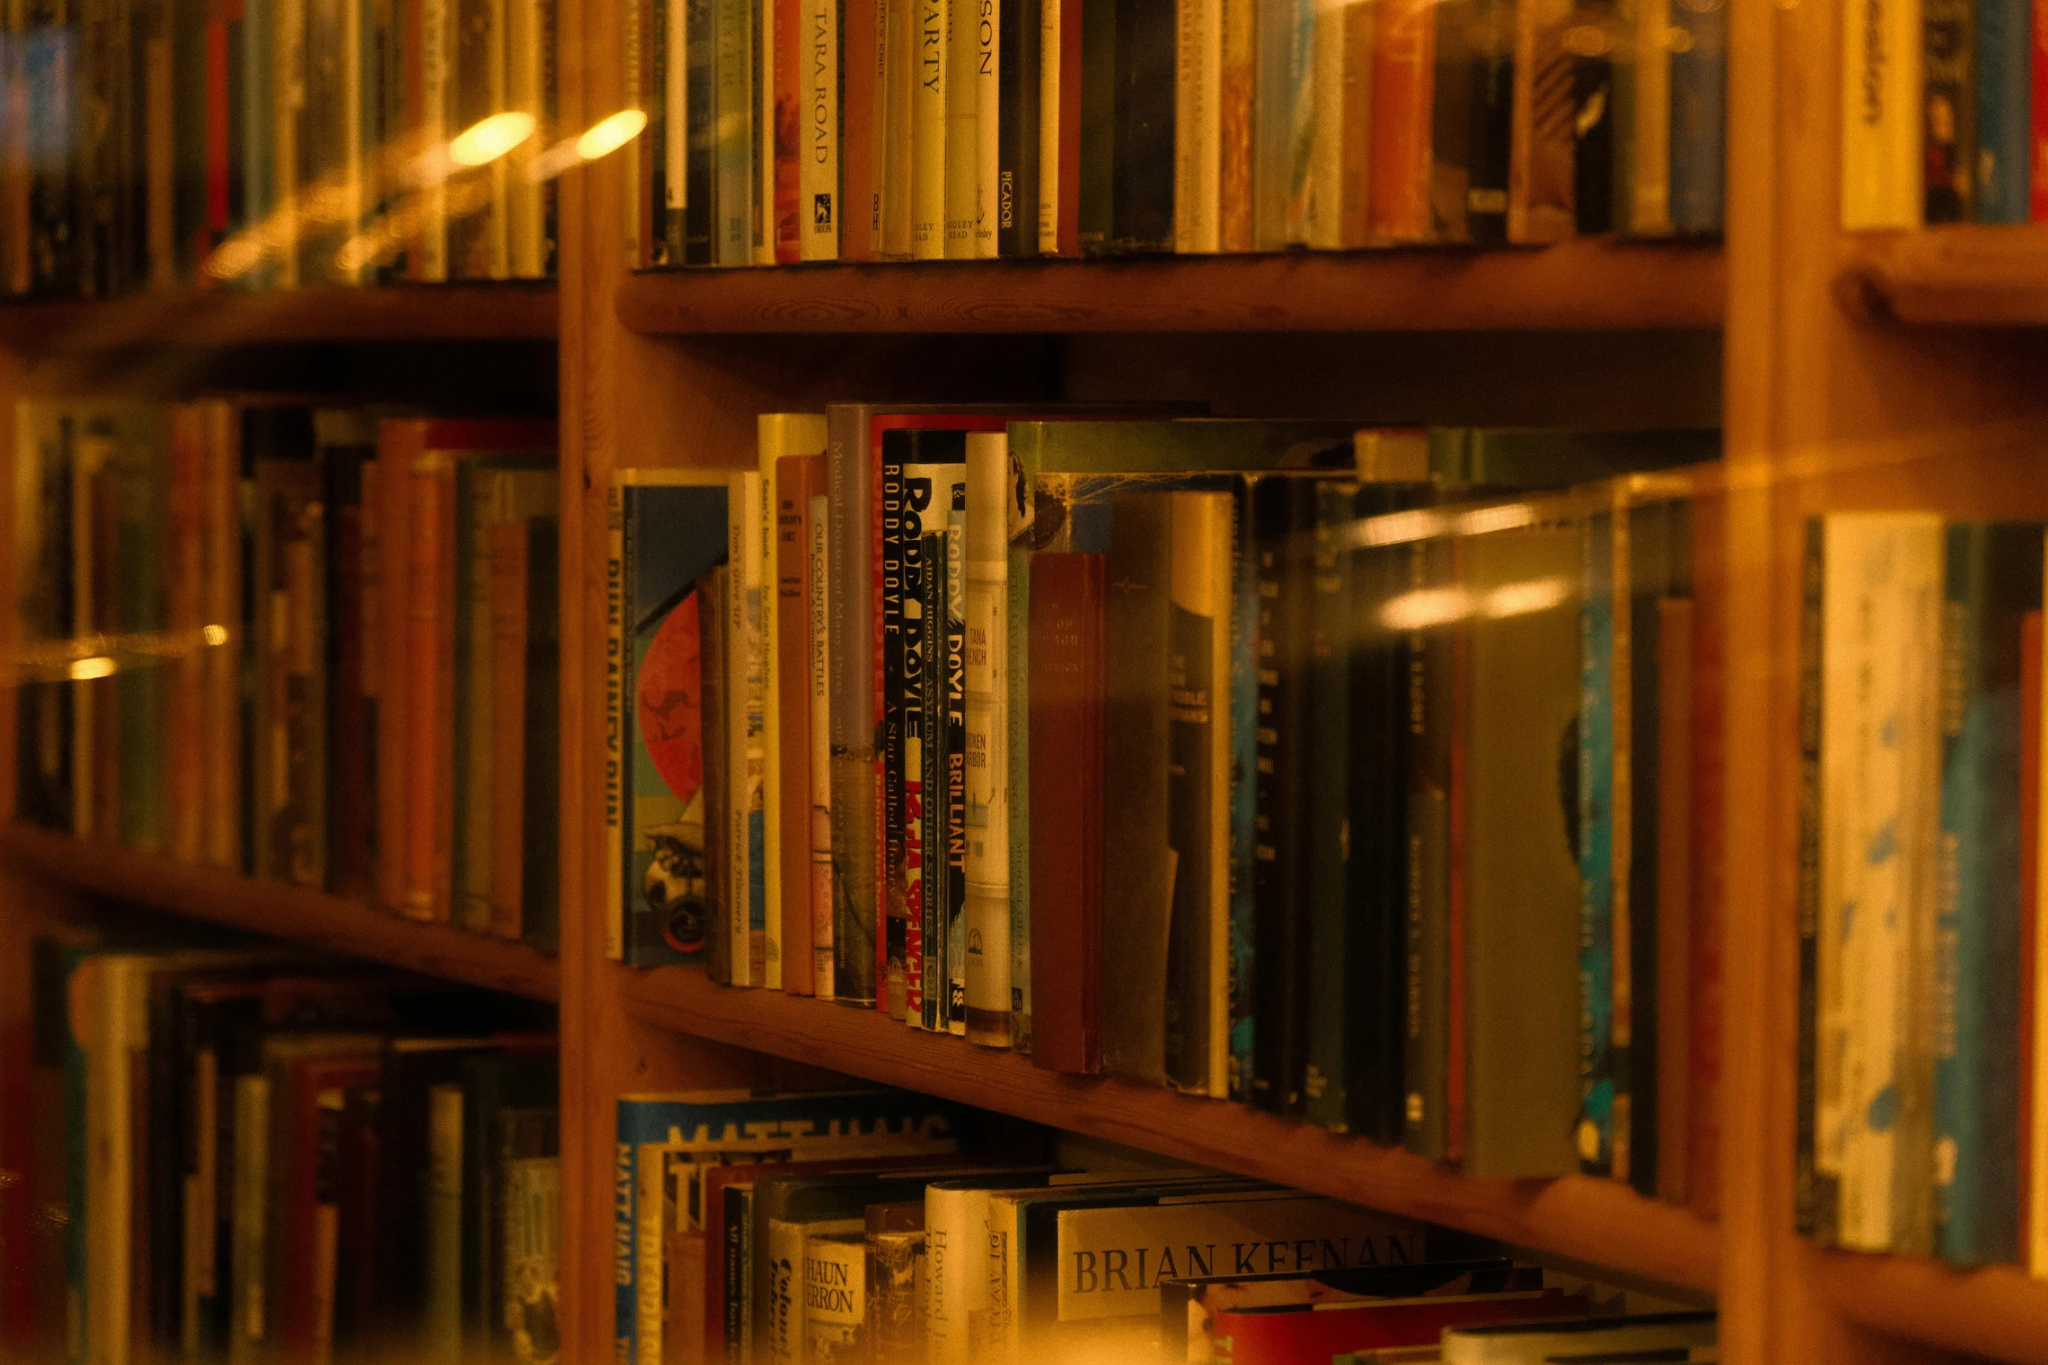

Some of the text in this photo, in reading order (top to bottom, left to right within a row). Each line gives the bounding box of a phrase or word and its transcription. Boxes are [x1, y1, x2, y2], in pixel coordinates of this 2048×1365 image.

[923, 0, 940, 94] ARTY
[814, 7, 829, 165] TARA ROAD
[1001, 170, 1014, 230] PICADOR
[833, 441, 844, 507] Medical
[833, 513, 844, 572] Doctor
[884, 464, 900, 636] RODDY DOYLE
[814, 523, 828, 697] OUR COUNTRY'S BATTLES
[832, 602, 844, 649] Many
[925, 556, 935, 663] AIDAN HIGGINS
[947, 523, 963, 728] RODDY DOYLE
[970, 627, 987, 646] TANA
[834, 655, 844, 696] Parts
[887, 721, 898, 763] Star
[887, 769, 898, 829] Called
[925, 676, 935, 936] ASYLUM AND OTHER STORIES
[948, 753, 966, 873] BRILLIANT
[886, 838, 898, 896] Henry
[615, 1143, 632, 1218] MATT
[806, 1257, 848, 1286] HAUN
[934, 1229, 948, 1323] Howard
[1073, 1233, 1416, 1294] BRIAN KEENAN
[779, 1257, 792, 1359] Colonel
[806, 1283, 853, 1313] ERRON
